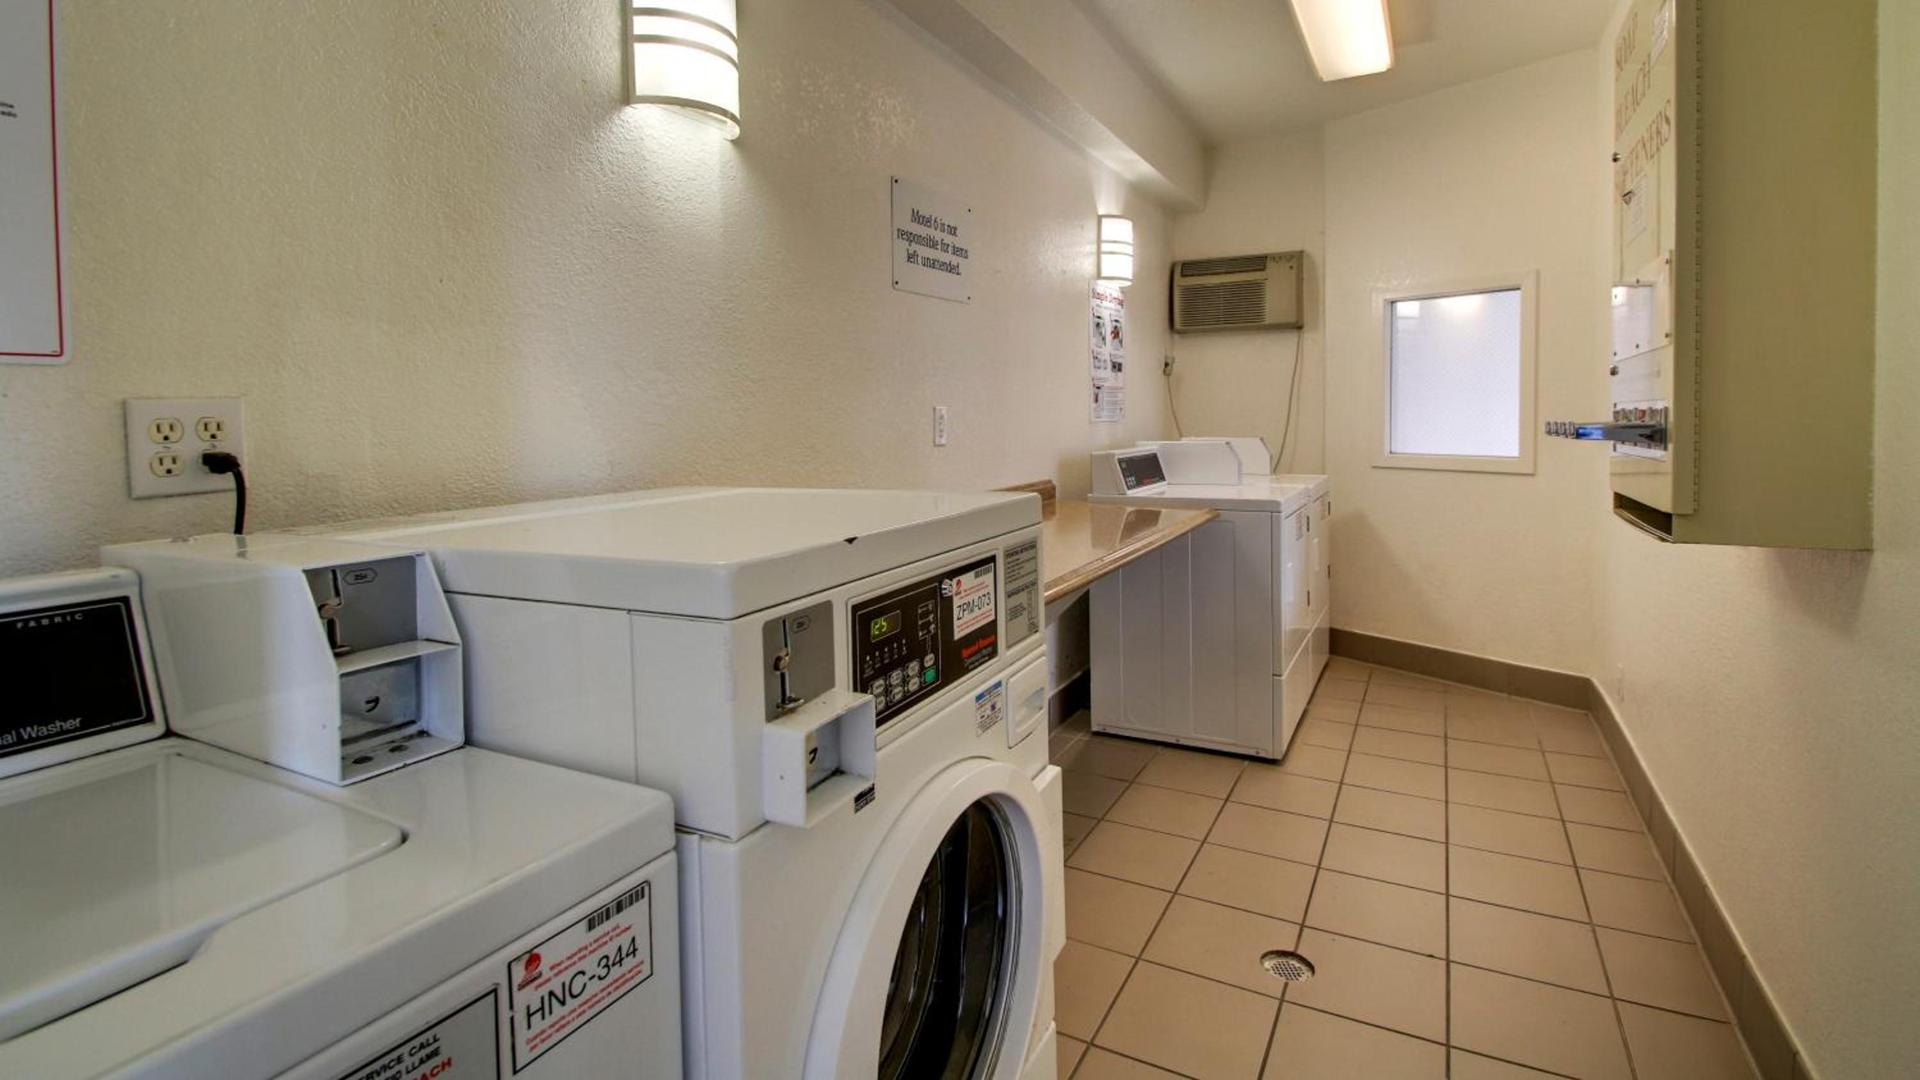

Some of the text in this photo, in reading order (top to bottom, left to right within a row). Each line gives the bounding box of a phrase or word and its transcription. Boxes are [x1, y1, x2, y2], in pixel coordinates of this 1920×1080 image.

[911, 207, 932, 229] Motel
[934, 216, 938, 231] 6
[897, 228, 940, 251] responsible
[941, 238, 950, 254] for
[907, 248, 919, 265] left
[956, 592, 992, 621] ZPM-073
[16, 613, 84, 629] FABRIC
[20, 717, 83, 740] Washer
[526, 935, 640, 1030] HNC-344
[408, 1033, 440, 1057] CALL
[405, 1046, 441, 1075] LLAME
[412, 1056, 452, 1080] ACH
